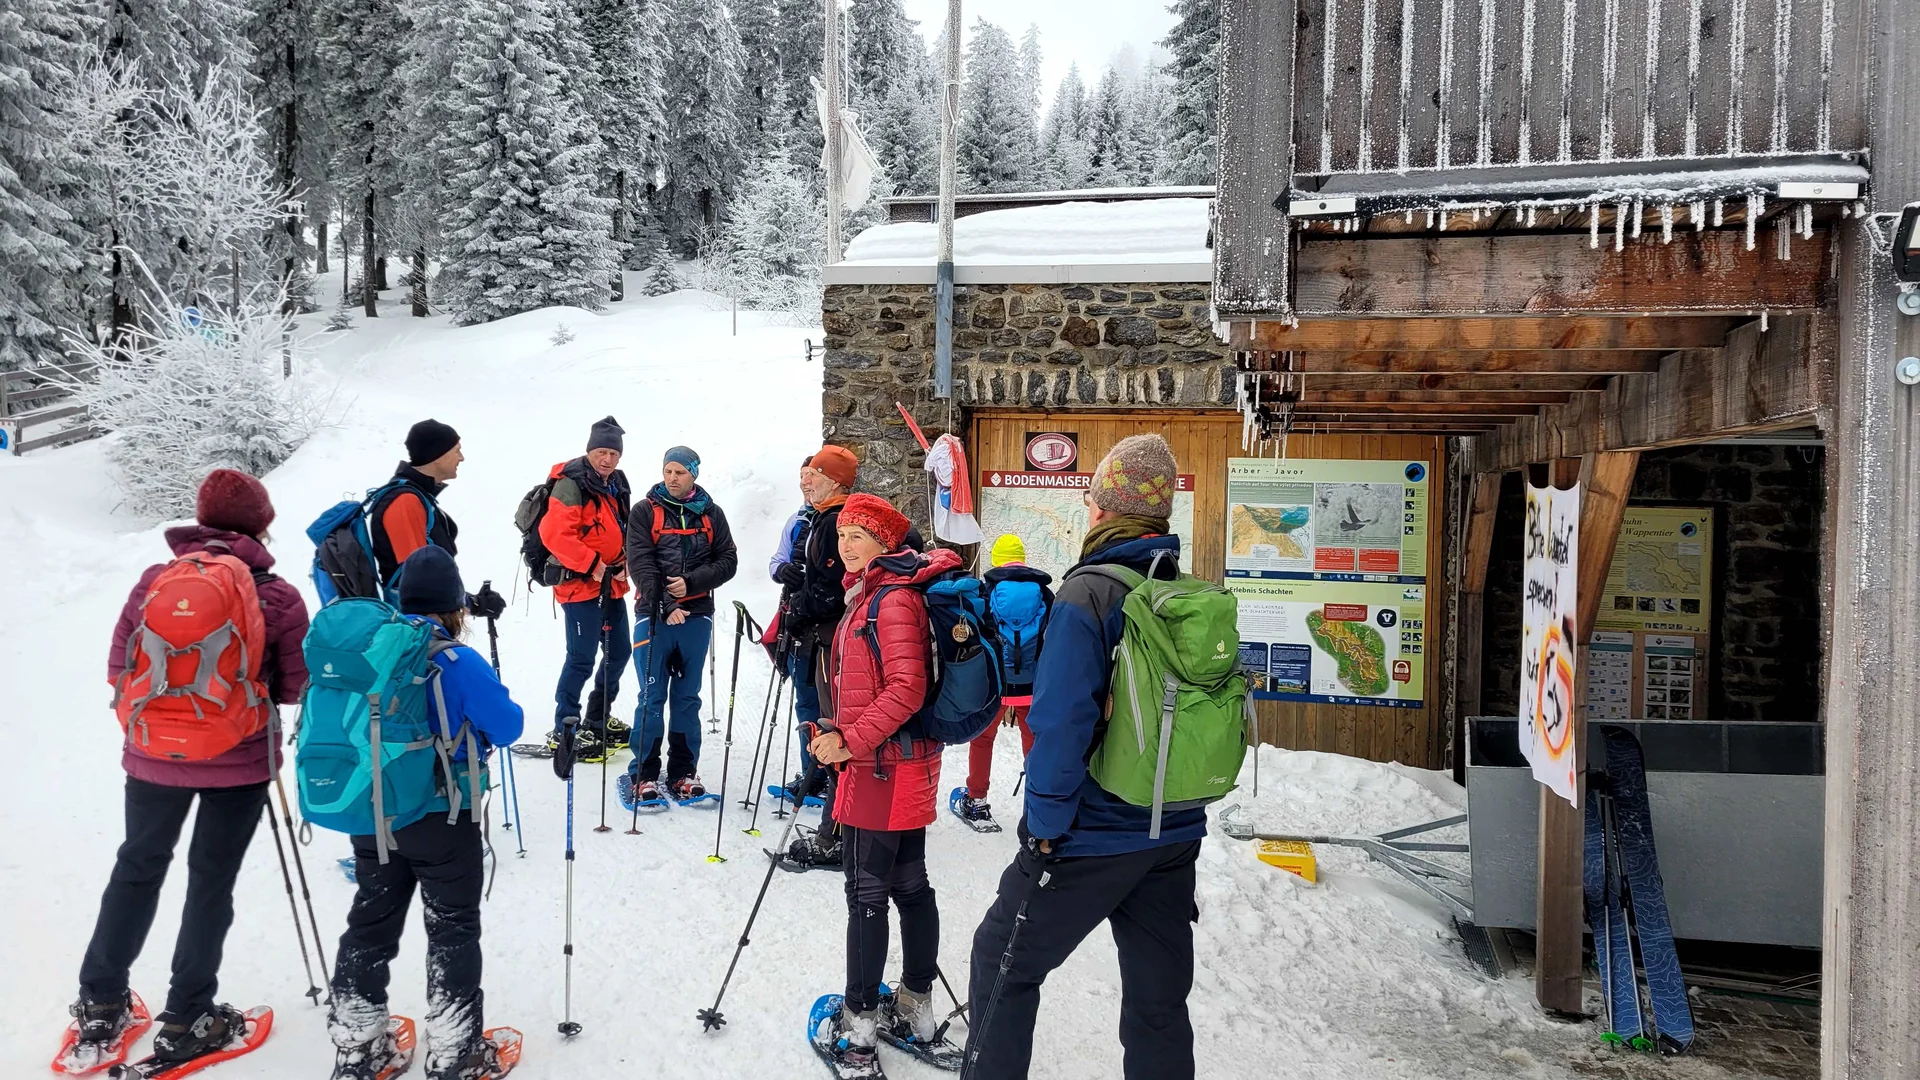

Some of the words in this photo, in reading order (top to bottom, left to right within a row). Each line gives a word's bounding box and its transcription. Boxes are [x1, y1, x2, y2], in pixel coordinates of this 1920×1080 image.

[1004, 474, 1090, 487] BODENMAISER
[1625, 527, 1675, 538] Wappentier
[1258, 587, 1293, 595] Schachten
